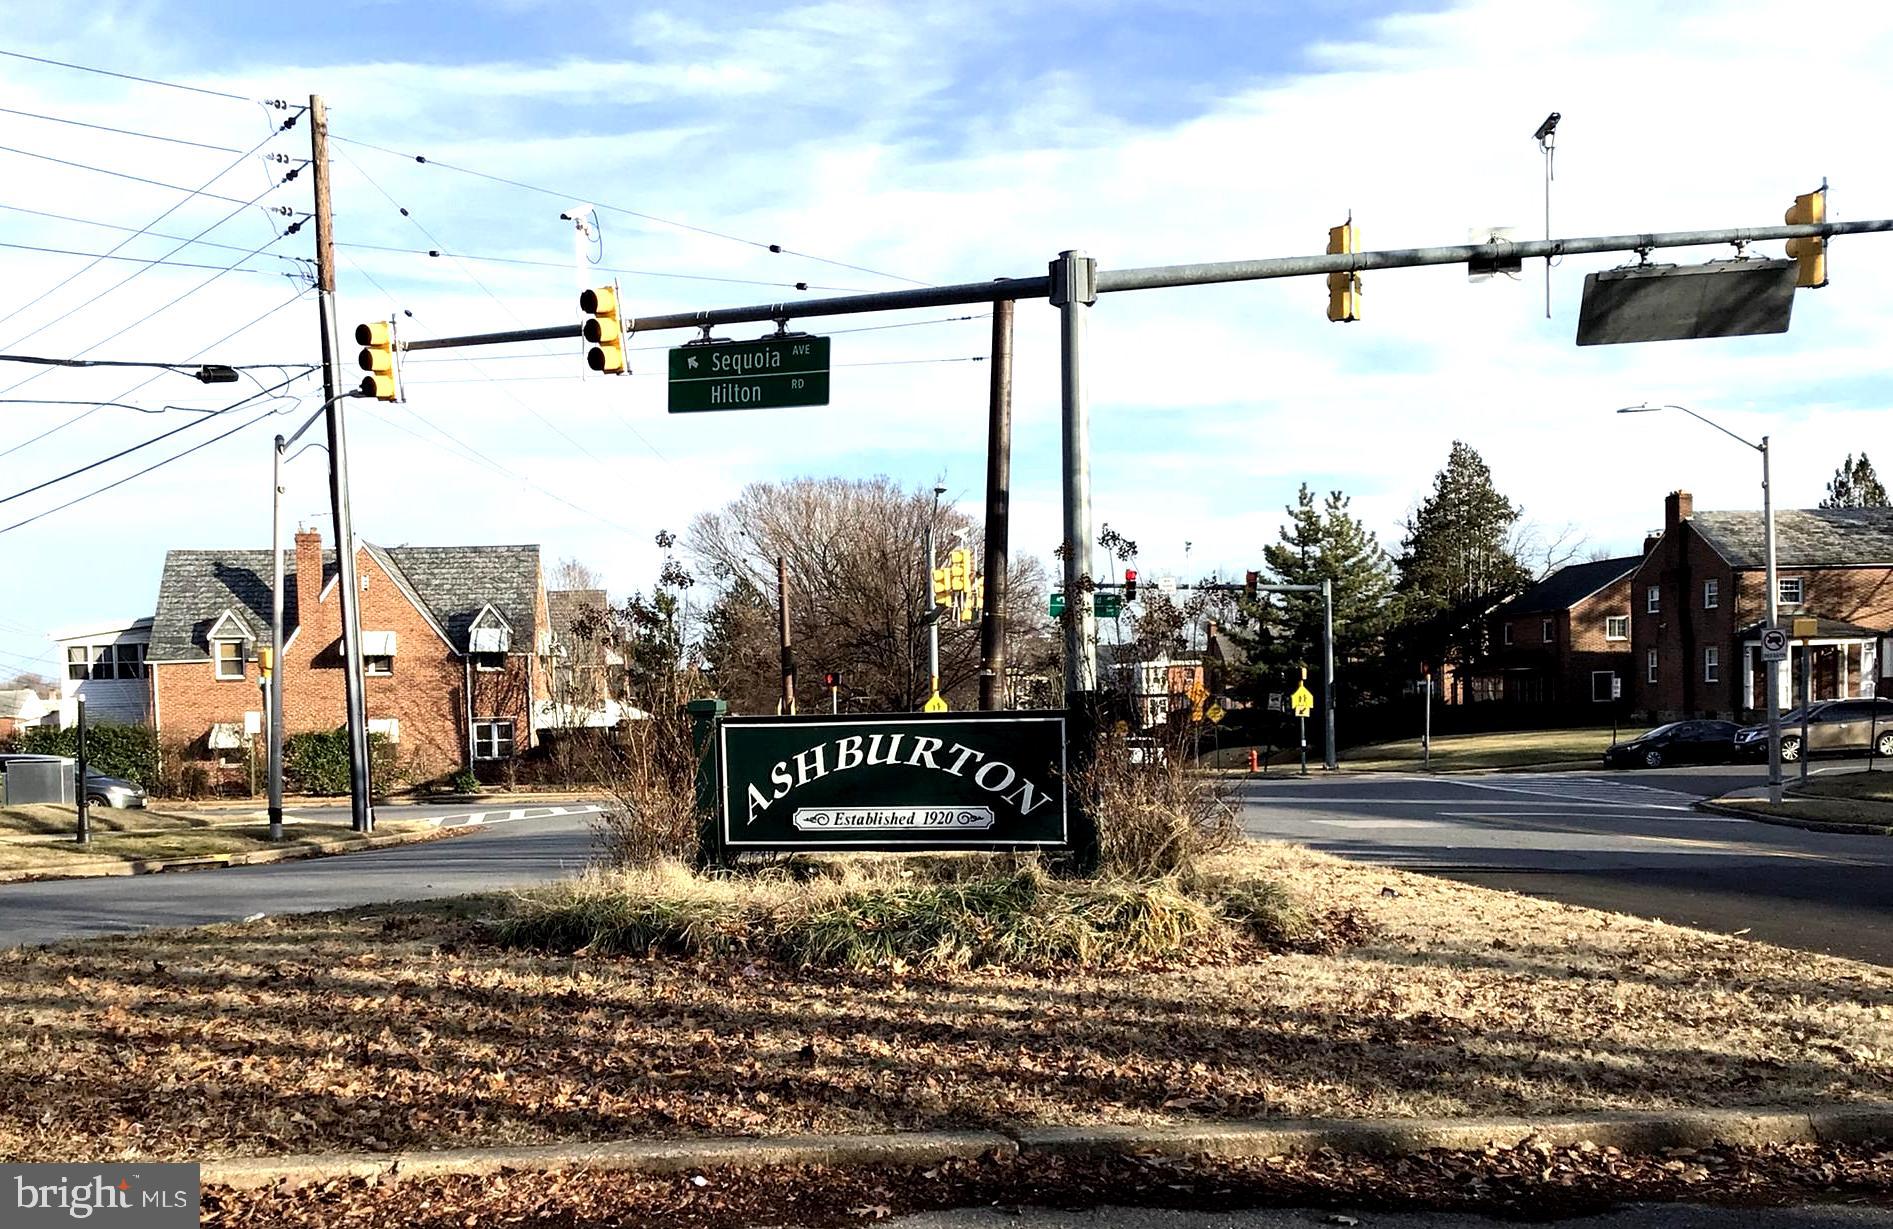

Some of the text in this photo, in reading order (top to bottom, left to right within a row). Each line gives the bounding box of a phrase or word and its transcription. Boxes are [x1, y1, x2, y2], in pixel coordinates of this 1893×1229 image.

[711, 344, 811, 375] Sequoia AVE
[711, 378, 805, 404] Hilton RD
[747, 733, 1053, 825] ASHBURTON
[833, 811, 954, 826] Established 1920
